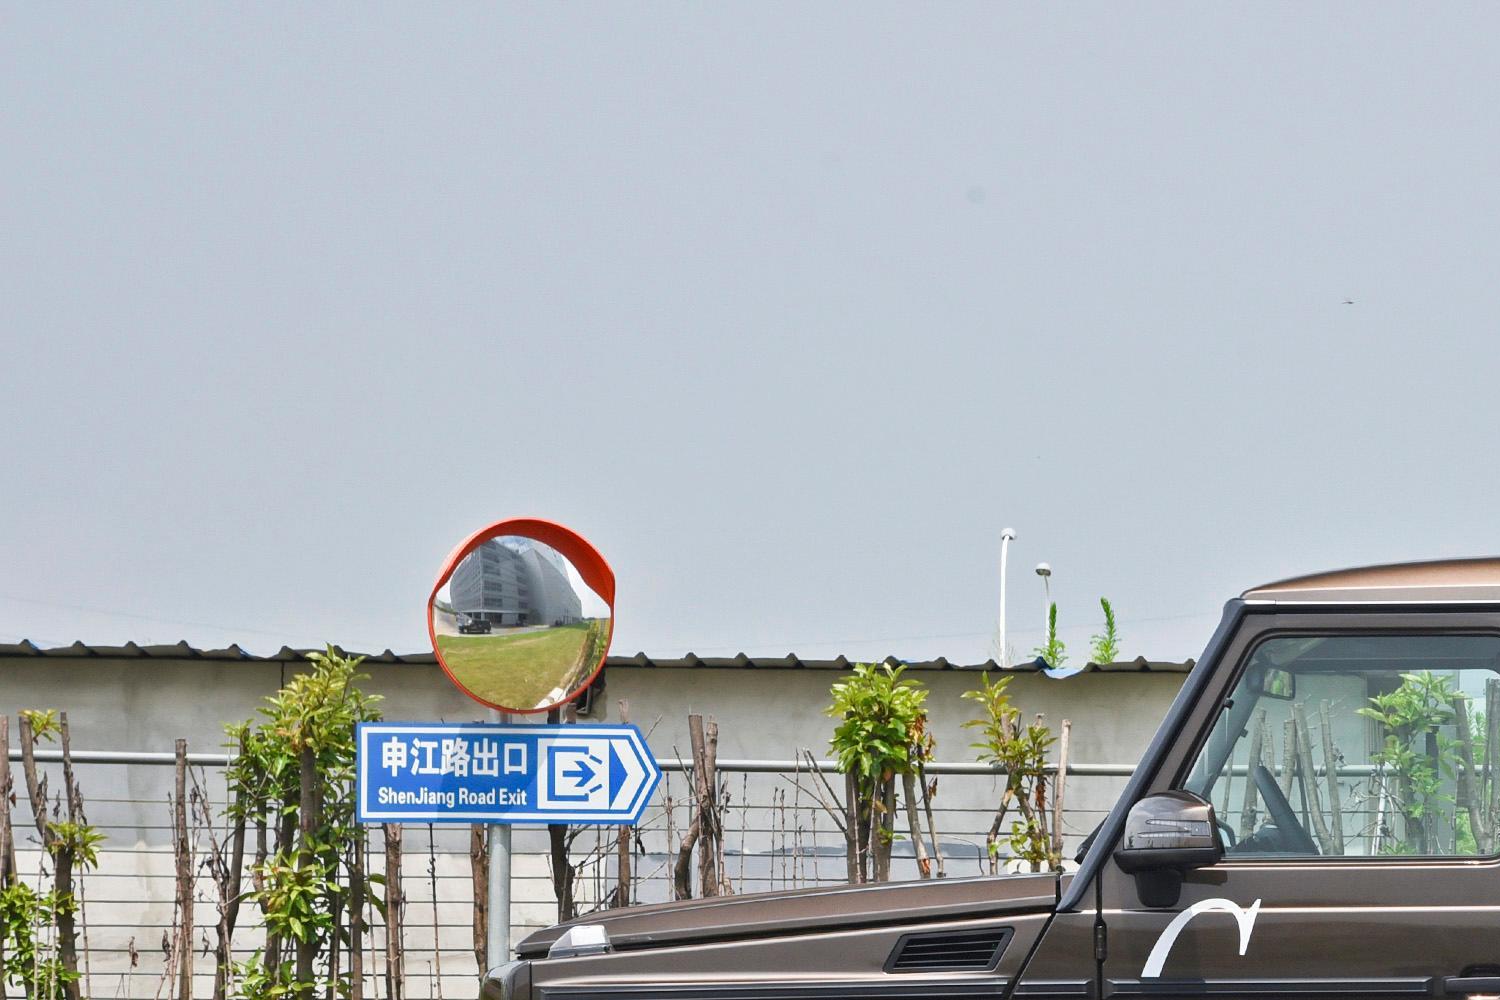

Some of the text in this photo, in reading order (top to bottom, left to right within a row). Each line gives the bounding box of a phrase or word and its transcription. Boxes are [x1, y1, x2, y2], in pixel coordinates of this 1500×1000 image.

[382, 736, 528, 777] 申江路出口
[378, 786, 527, 808] ShenJiang Road Exit
